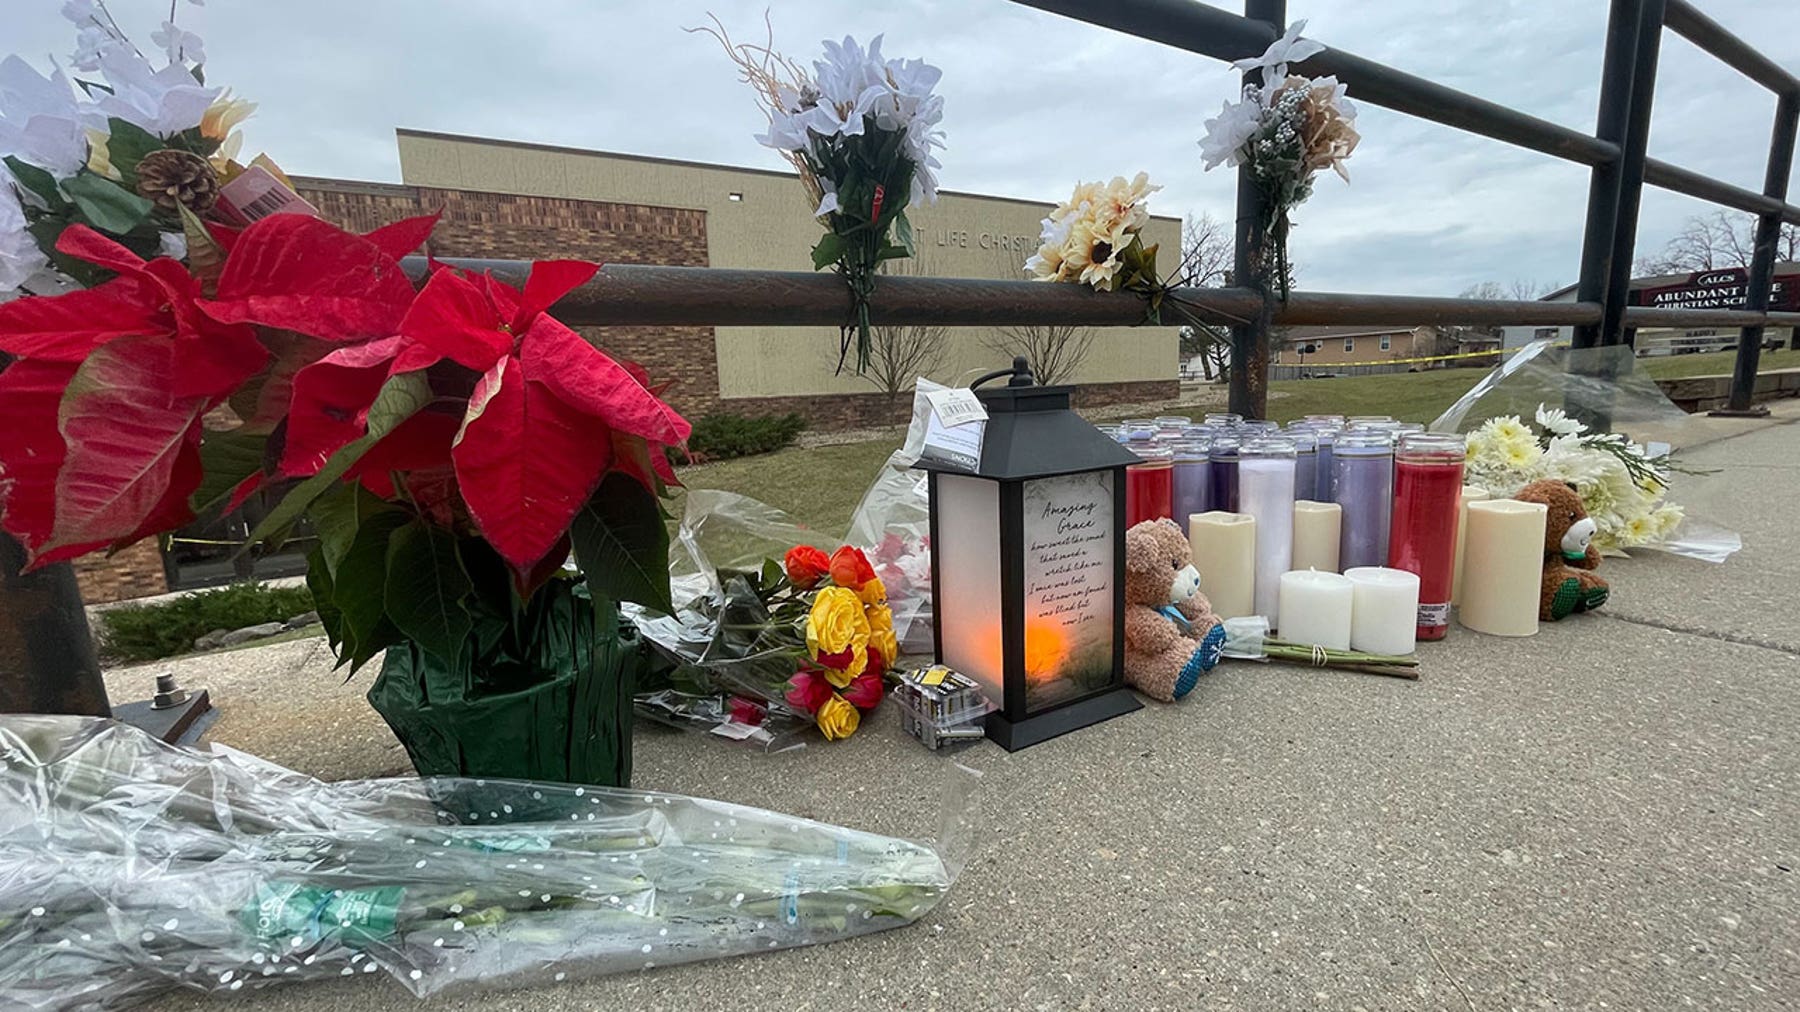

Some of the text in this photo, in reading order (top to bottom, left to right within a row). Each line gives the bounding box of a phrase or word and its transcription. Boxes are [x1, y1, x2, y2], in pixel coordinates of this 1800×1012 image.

[936, 230, 969, 248] LIFE
[1703, 274, 1735, 285] ALCS
[1654, 286, 1740, 303] ABUNDANT
[1656, 294, 1778, 309] CHRISTIAN SCHL
[1041, 501, 1097, 519] Amazing
[1057, 517, 1095, 534] Grace
